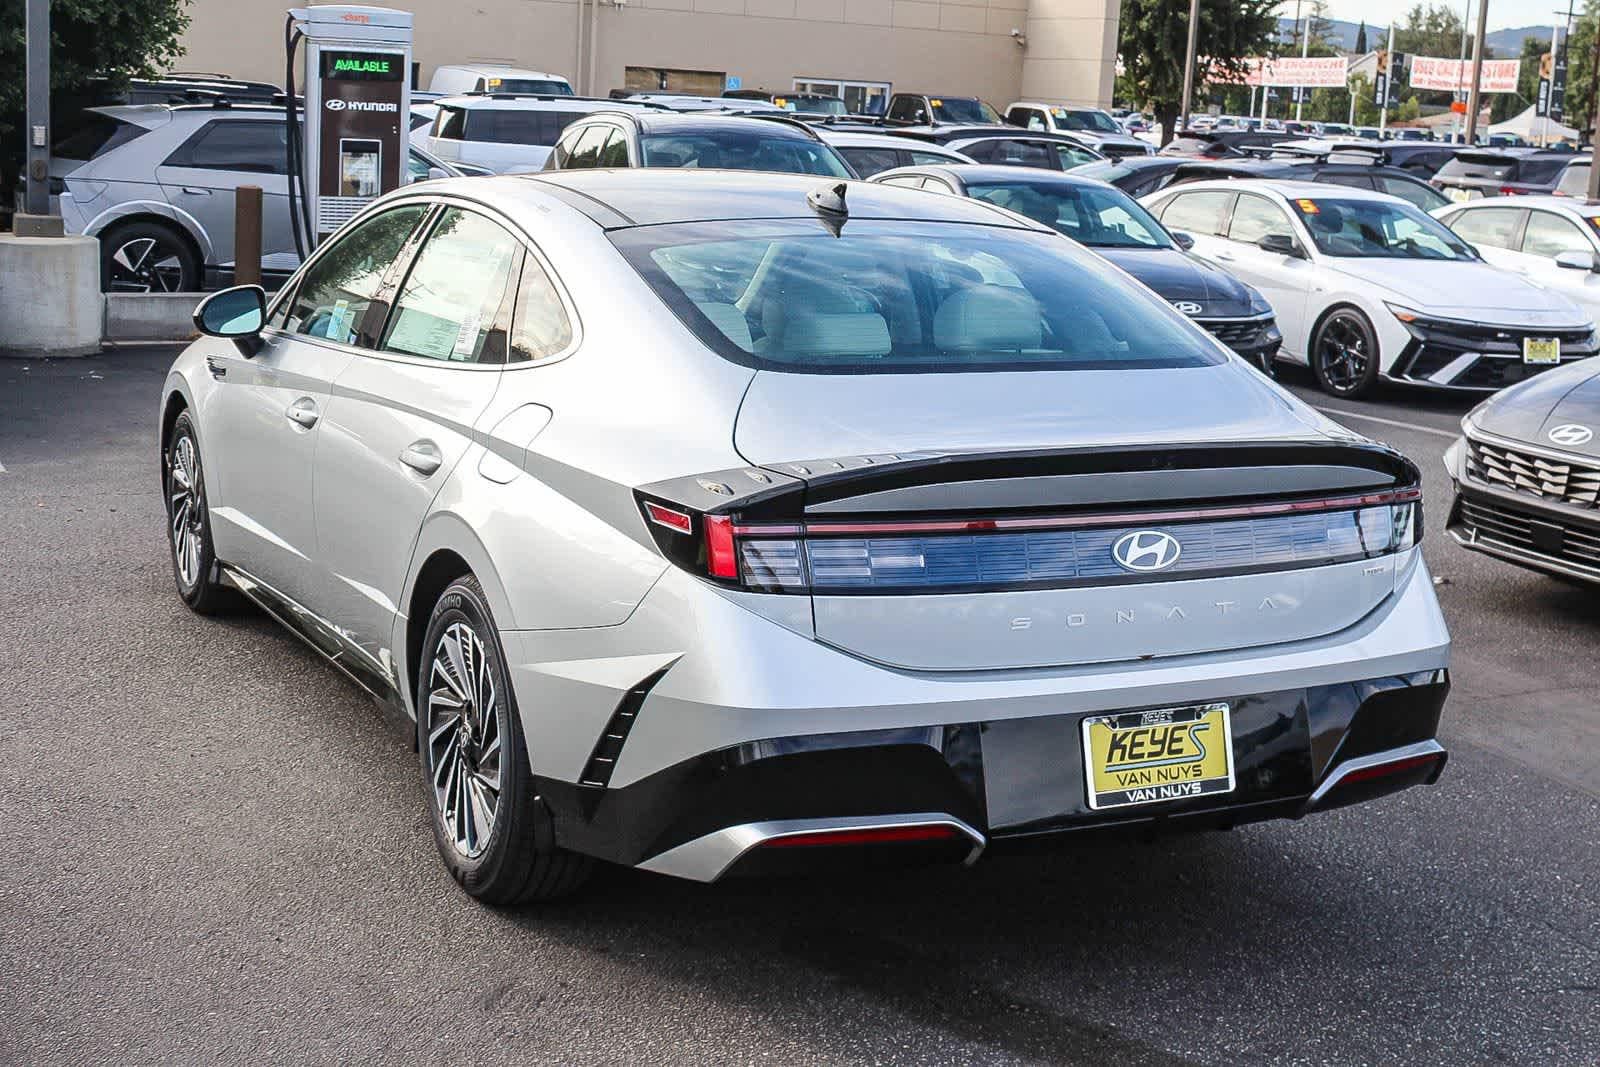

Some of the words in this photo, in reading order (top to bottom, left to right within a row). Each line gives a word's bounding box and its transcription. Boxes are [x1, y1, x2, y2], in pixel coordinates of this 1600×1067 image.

[334, 59, 389, 72] AVAILABLE
[348, 101, 397, 112] HYUNDAI
[1011, 597, 1278, 631] SONATA
[1106, 722, 1211, 763] KEYES
[1116, 770, 1152, 786] VAN
[1157, 764, 1203, 782] NUYS
[1126, 787, 1157, 802] VAN
[1160, 782, 1202, 798] NUYS
